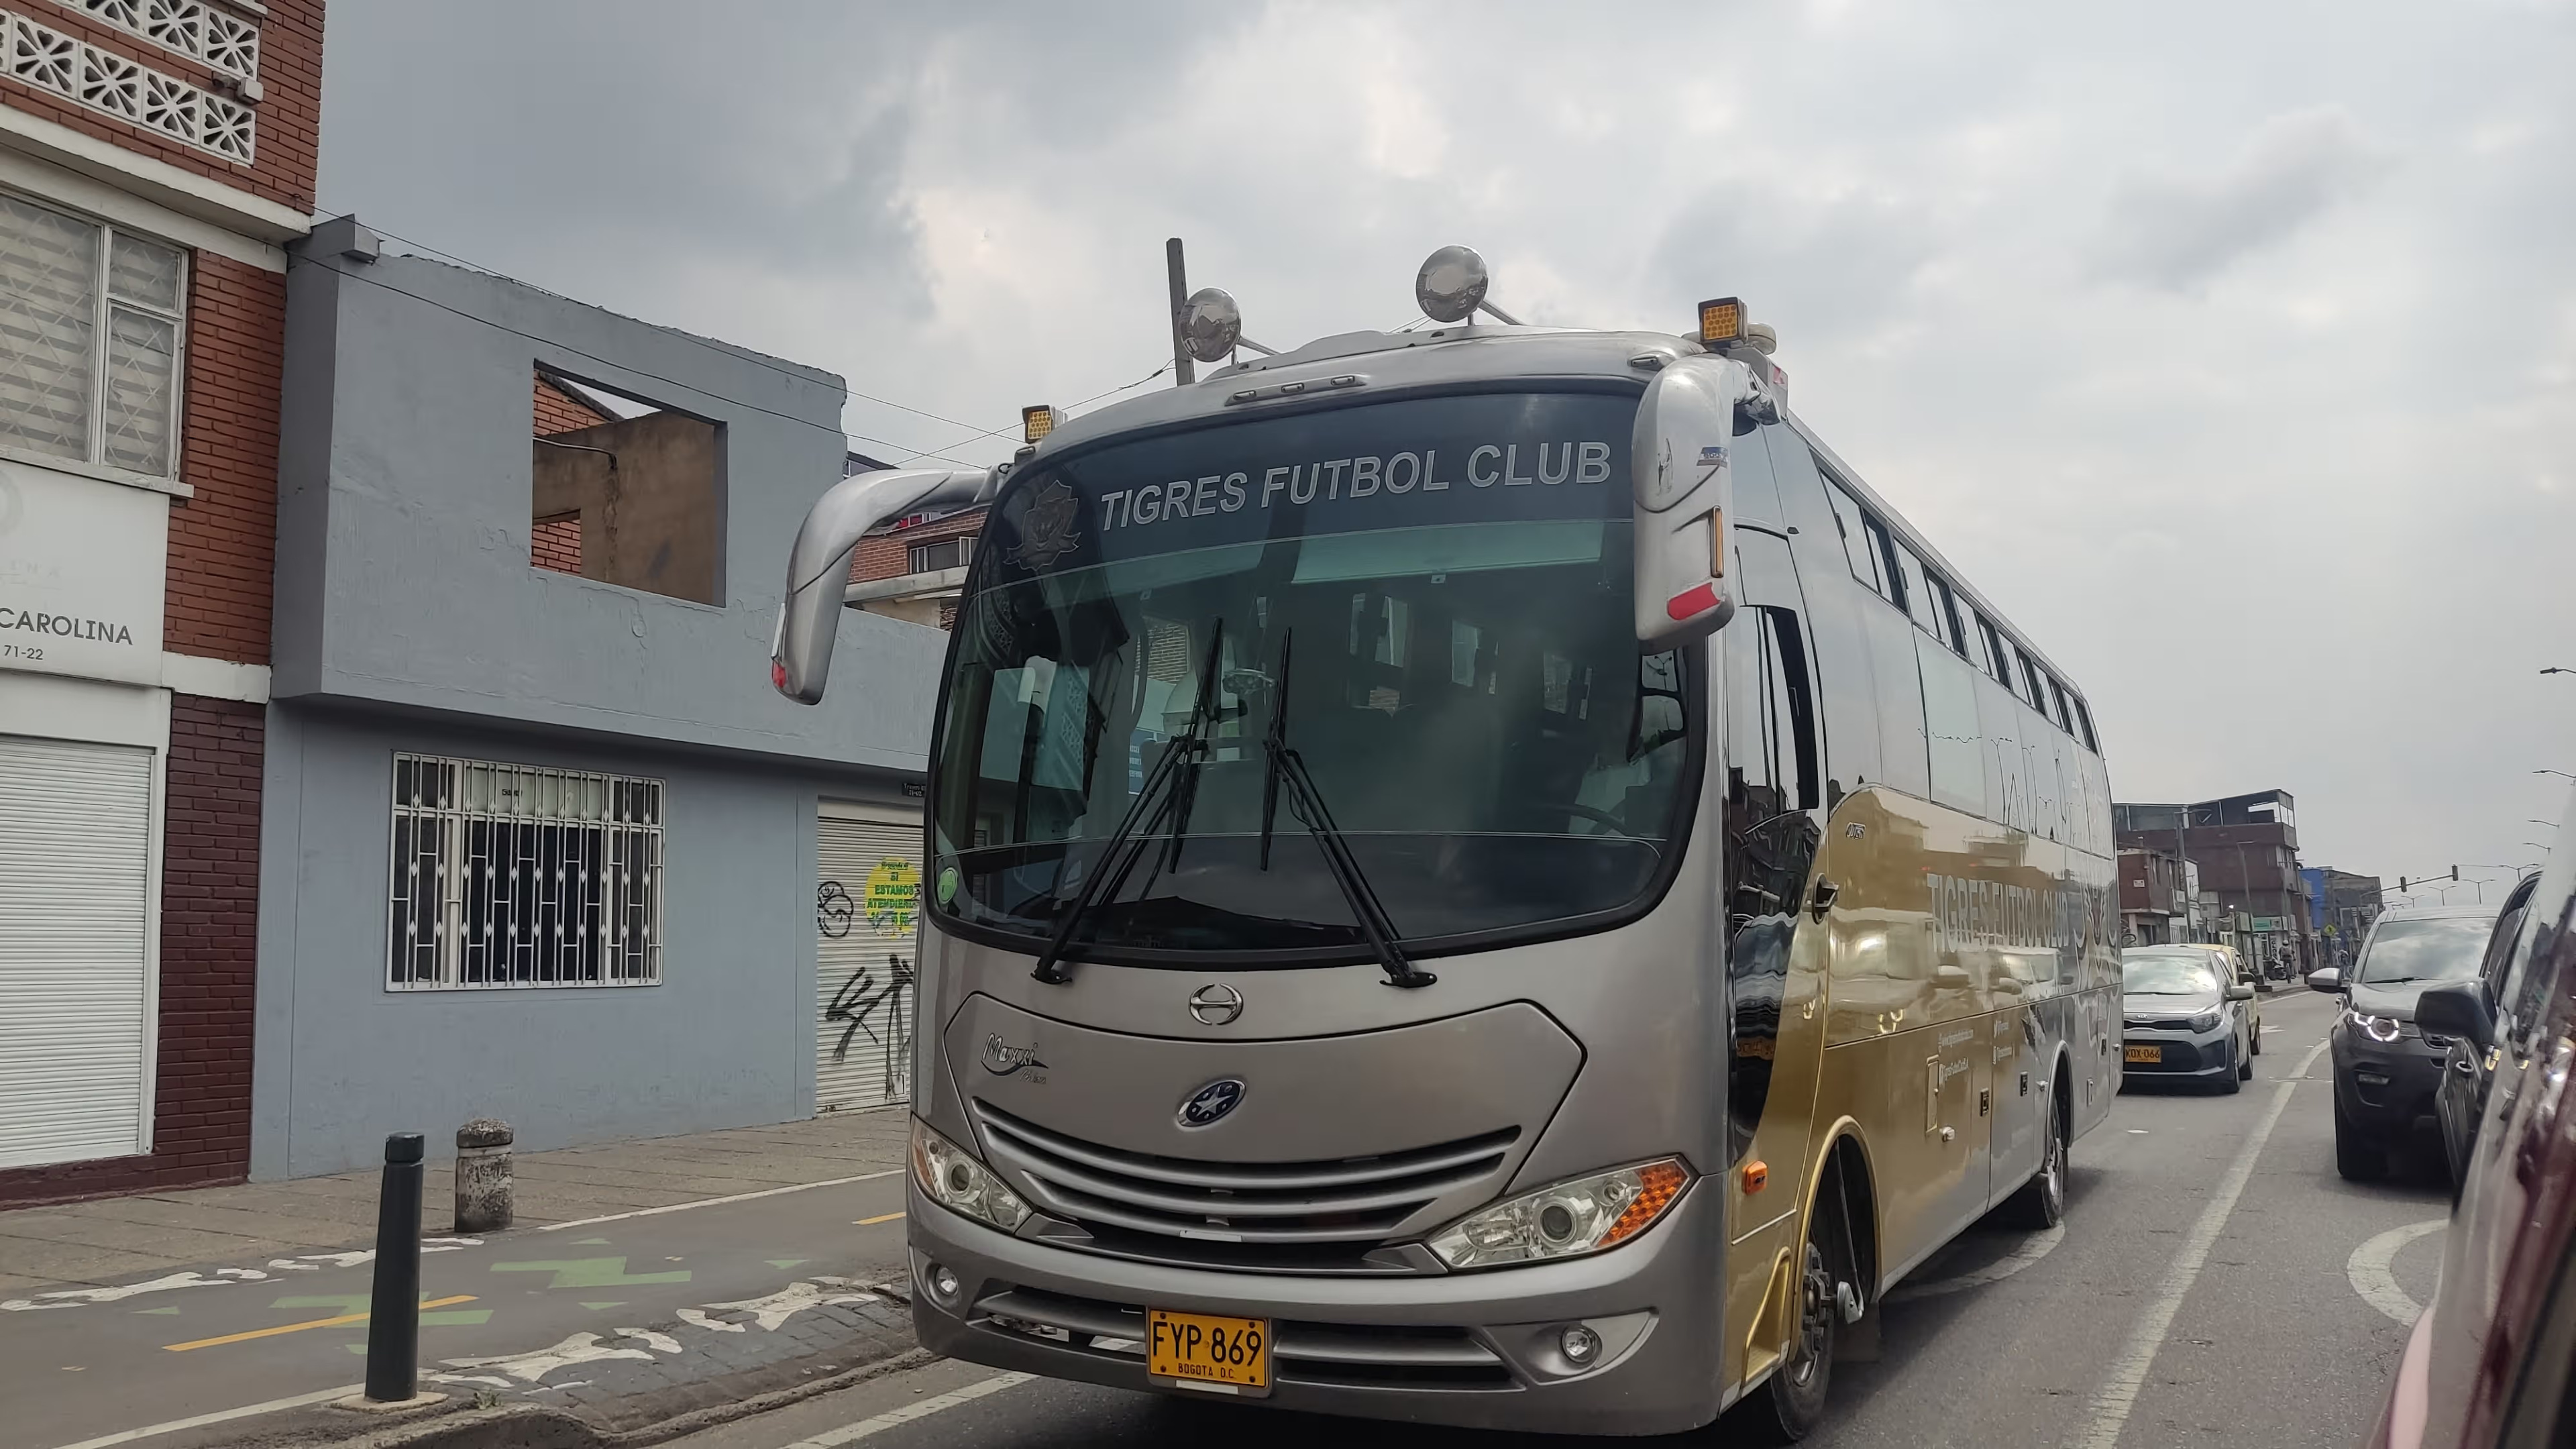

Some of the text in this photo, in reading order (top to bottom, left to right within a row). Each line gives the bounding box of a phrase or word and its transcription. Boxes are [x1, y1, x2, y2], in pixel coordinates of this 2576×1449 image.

[1100, 441, 1611, 531] TIGRES FUTBOL CLUB
[0, 607, 133, 645] CAROLINA
[4, 645, 44, 660] 71-22
[875, 885, 914, 895] ESTAMOS
[1927, 873, 1989, 953] TIGRES
[1153, 1321, 1262, 1367] FYP 869
[1178, 1362, 1214, 1377] BOGOTA
